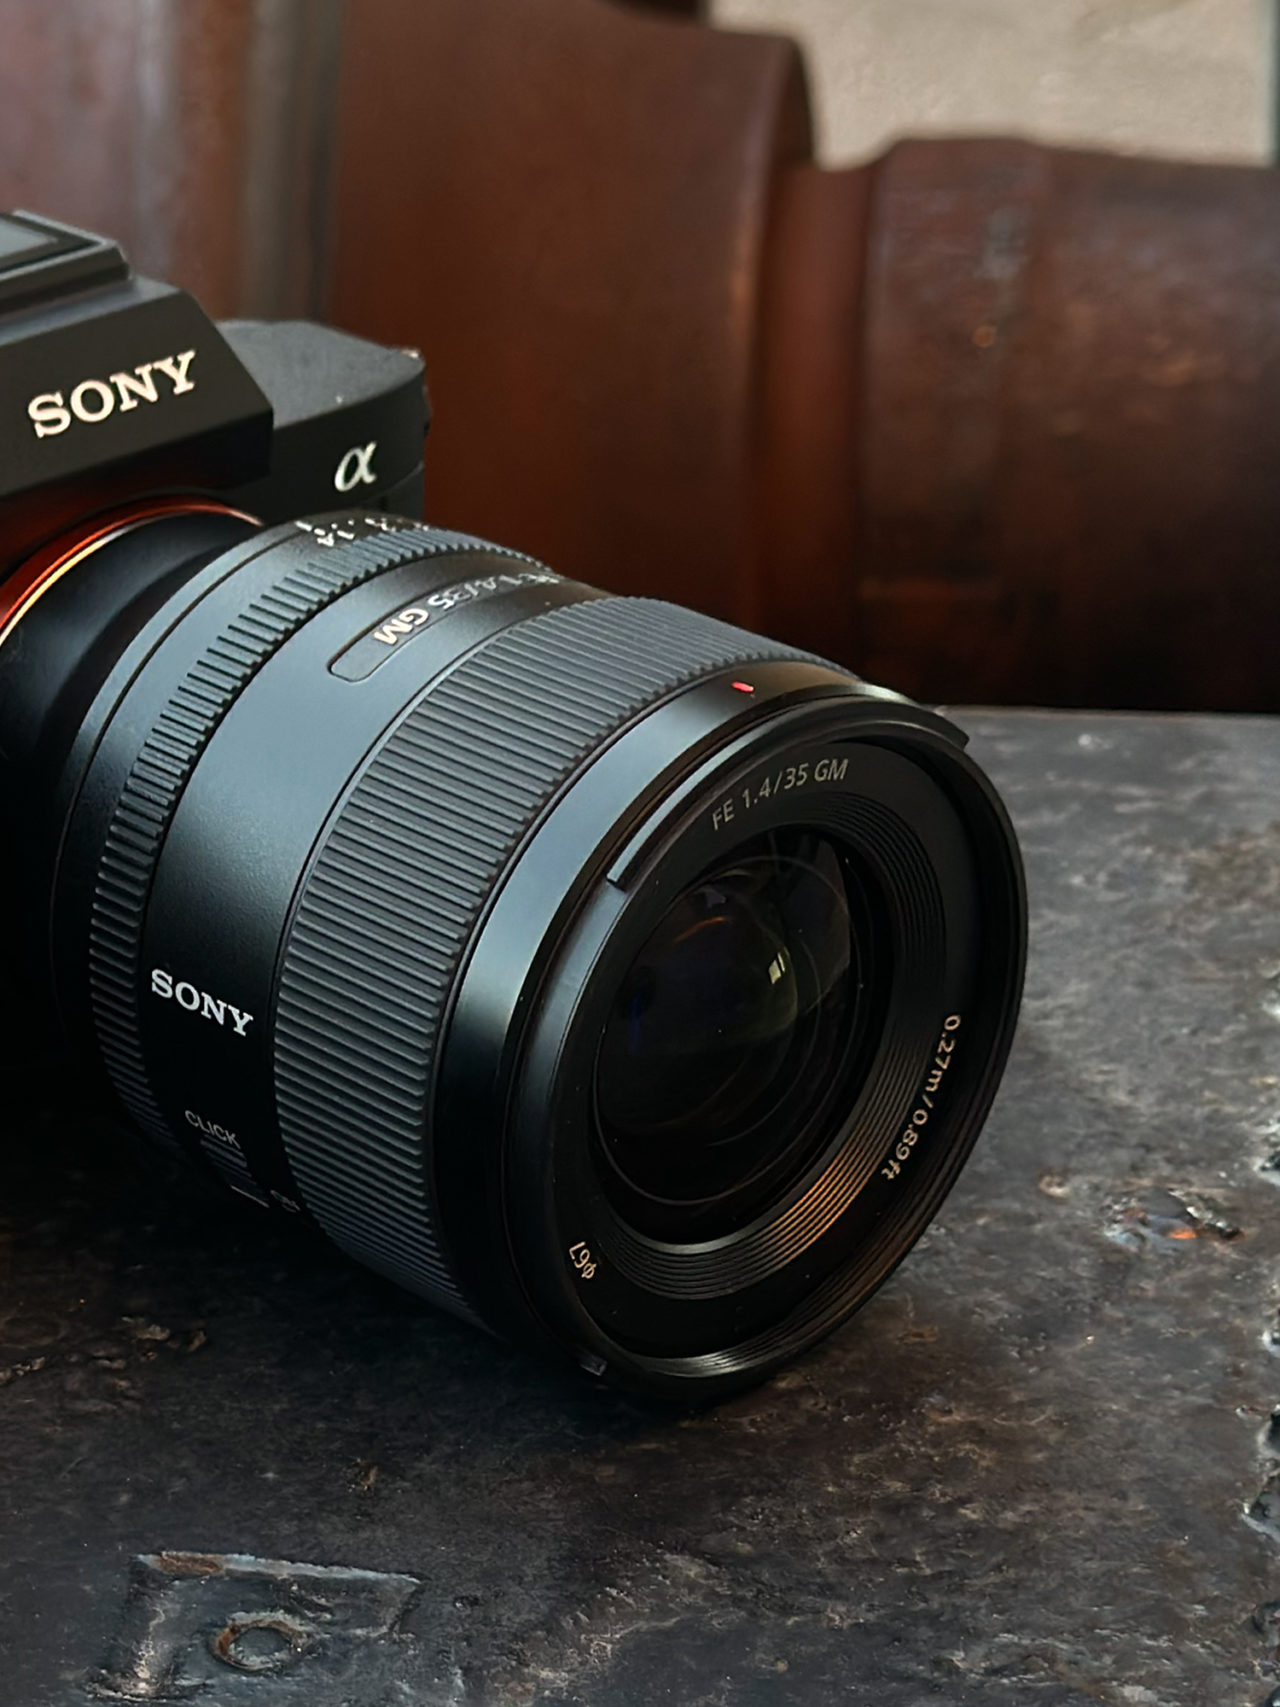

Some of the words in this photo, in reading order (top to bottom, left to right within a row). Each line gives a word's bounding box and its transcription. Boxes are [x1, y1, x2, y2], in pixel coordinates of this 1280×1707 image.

[27, 350, 197, 438] SONY
[373, 607, 429, 646] GM
[712, 798, 735, 831] FE
[742, 763, 810, 808] 1.4/35
[814, 758, 849, 782] GM
[151, 968, 254, 1037] SONY
[184, 1109, 242, 1150] CLICK
